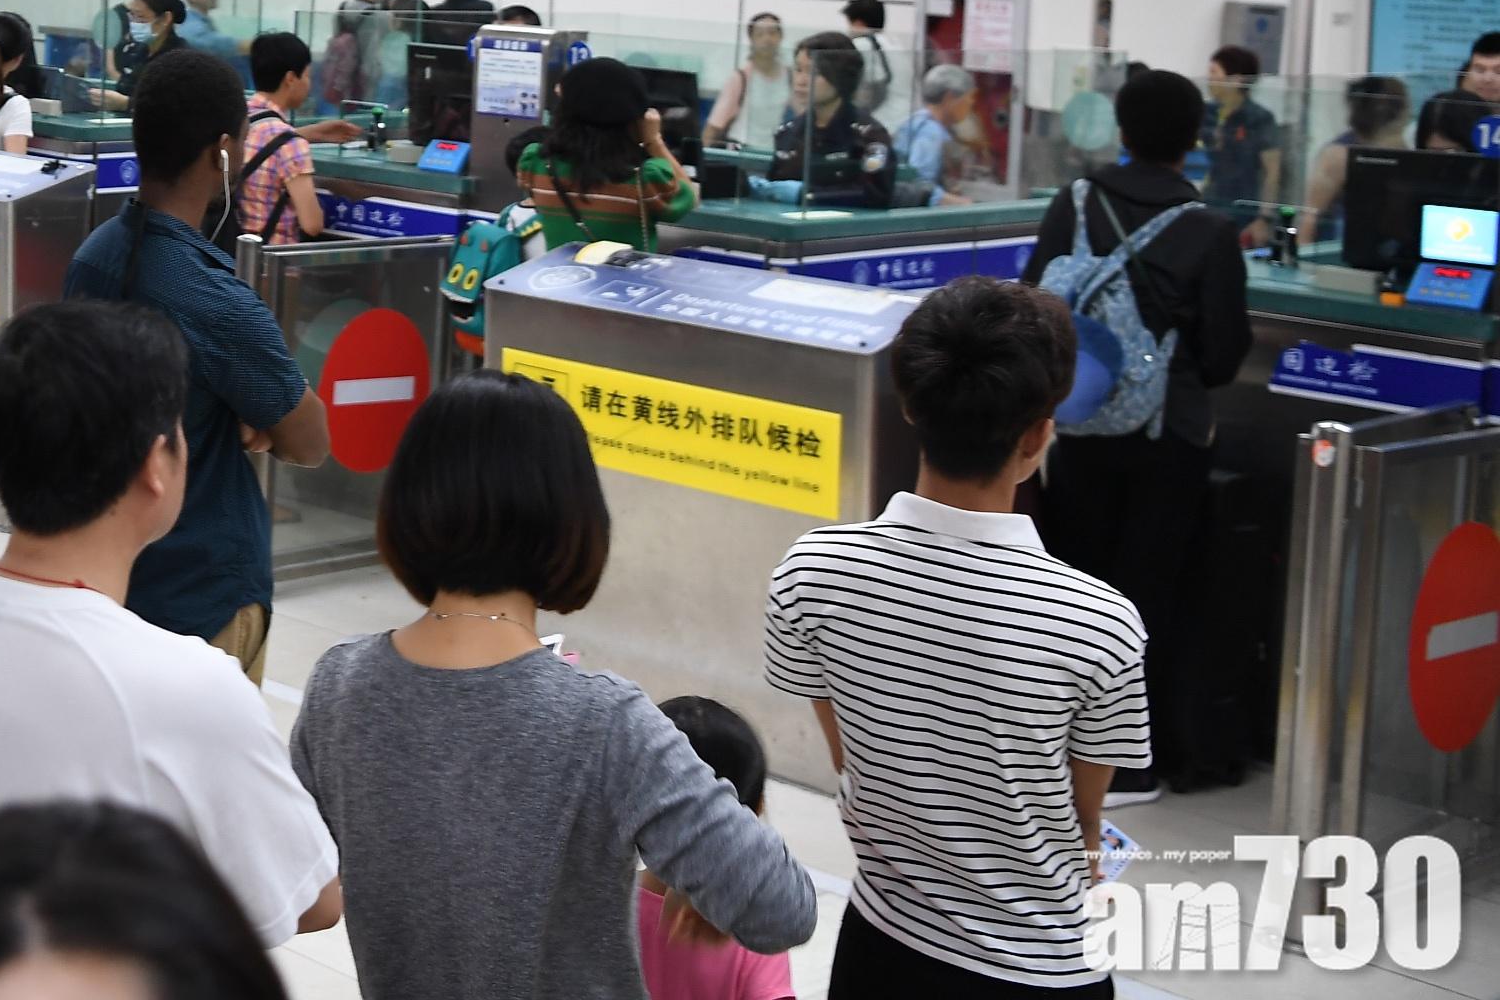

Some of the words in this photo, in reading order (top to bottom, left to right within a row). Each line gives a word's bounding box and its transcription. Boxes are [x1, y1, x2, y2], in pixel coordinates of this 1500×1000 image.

[580, 384, 821, 458] 请在黄线外排队候检
[626, 442, 666, 459] queue
[669, 450, 716, 470] behind
[718, 461, 741, 475] the
[744, 468, 789, 486] yellow
[792, 476, 820, 493] line
